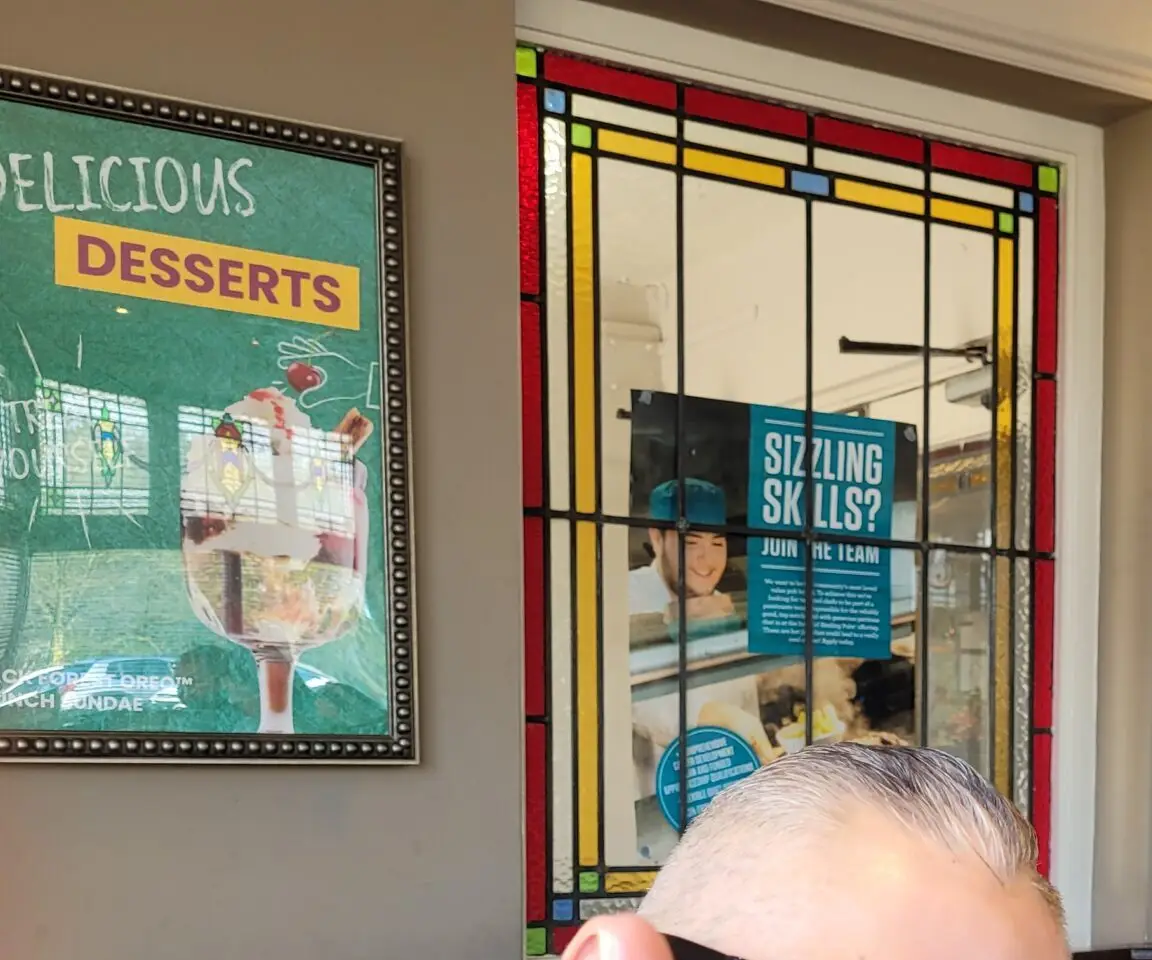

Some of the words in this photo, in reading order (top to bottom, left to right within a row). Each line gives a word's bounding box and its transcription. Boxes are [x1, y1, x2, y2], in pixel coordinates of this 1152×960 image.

[77, 233, 342, 313] DESSERTS
[764, 431, 883, 485] SIZZLING
[762, 477, 882, 533] SKLLS?
[761, 537, 798, 558] JOIN
[811, 540, 832, 561] HE
[838, 543, 880, 565] TEAM
